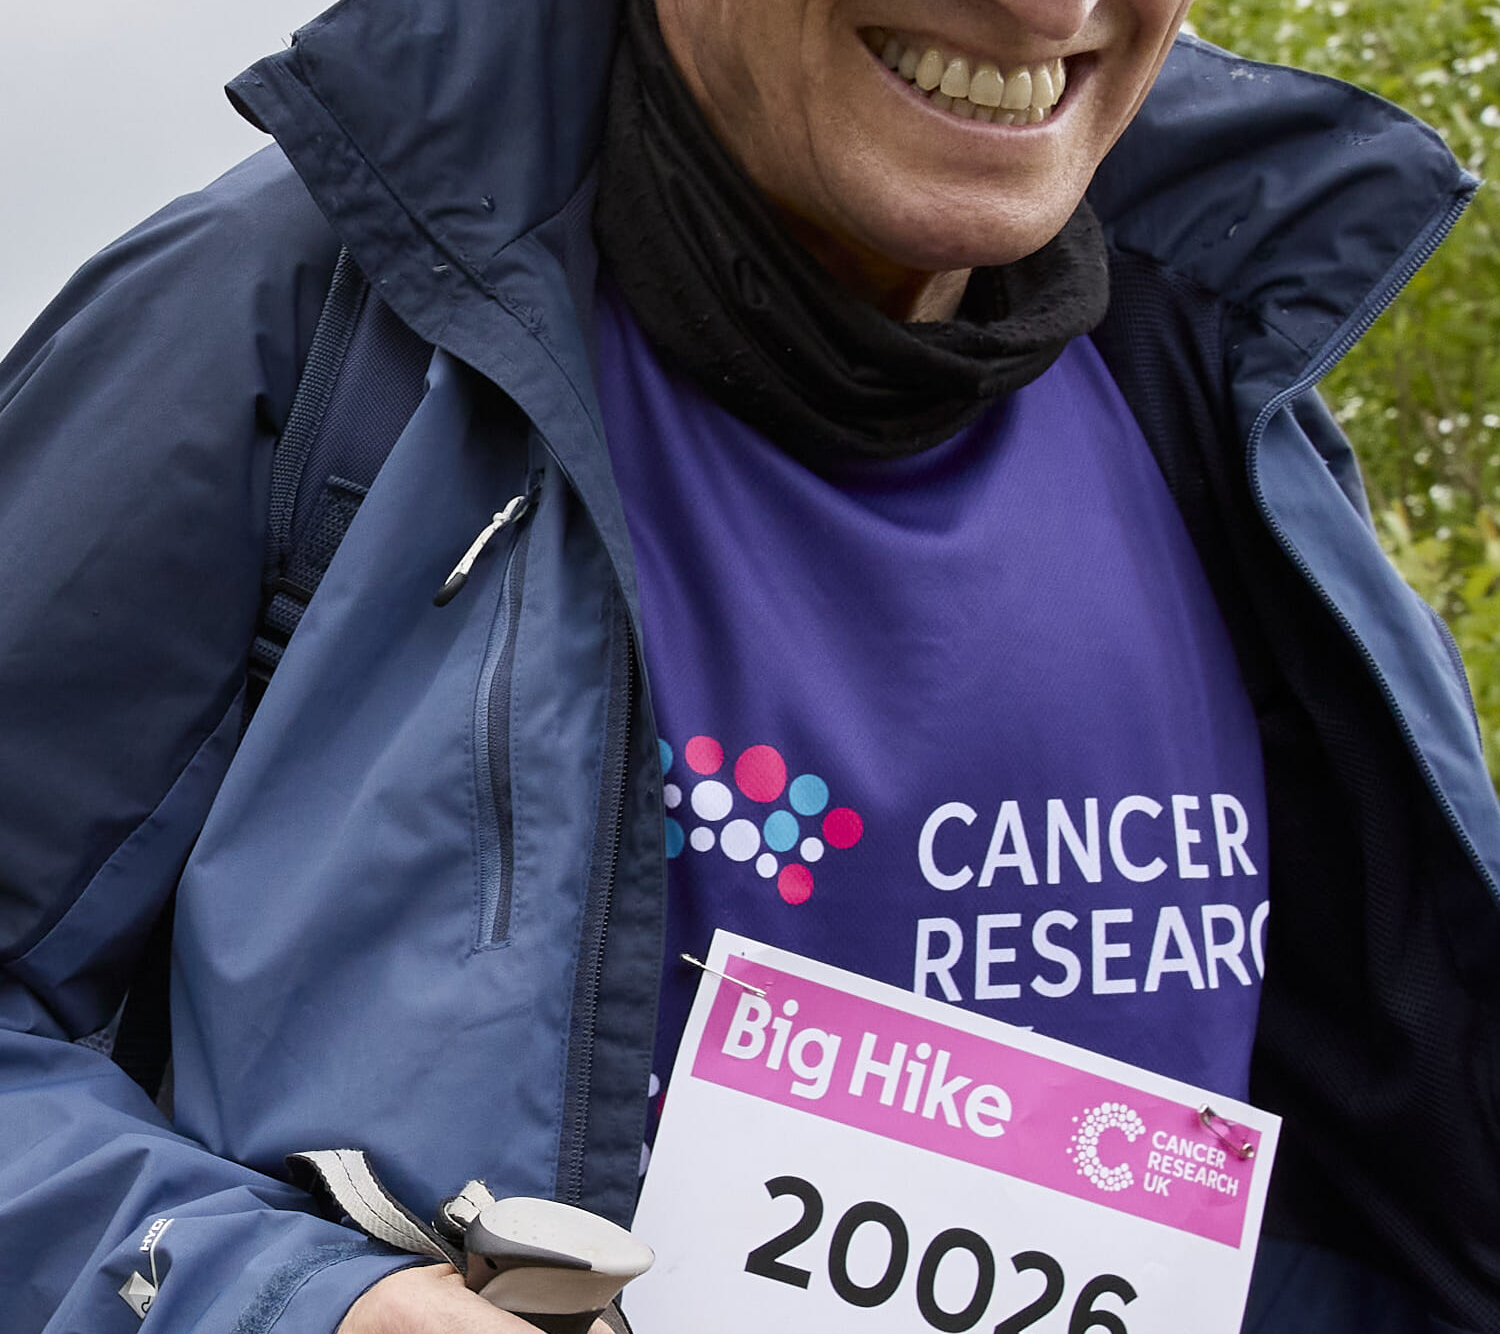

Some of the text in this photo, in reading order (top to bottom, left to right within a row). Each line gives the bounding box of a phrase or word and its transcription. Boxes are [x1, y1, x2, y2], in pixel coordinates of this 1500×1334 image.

[918, 793, 1258, 891] CANCER
[721, 992, 1012, 1138] Big Hike
[1151, 1131, 1227, 1169] CANCER
[1143, 1172, 1172, 1196] UK
[1147, 1151, 1239, 1197] RESEARCH
